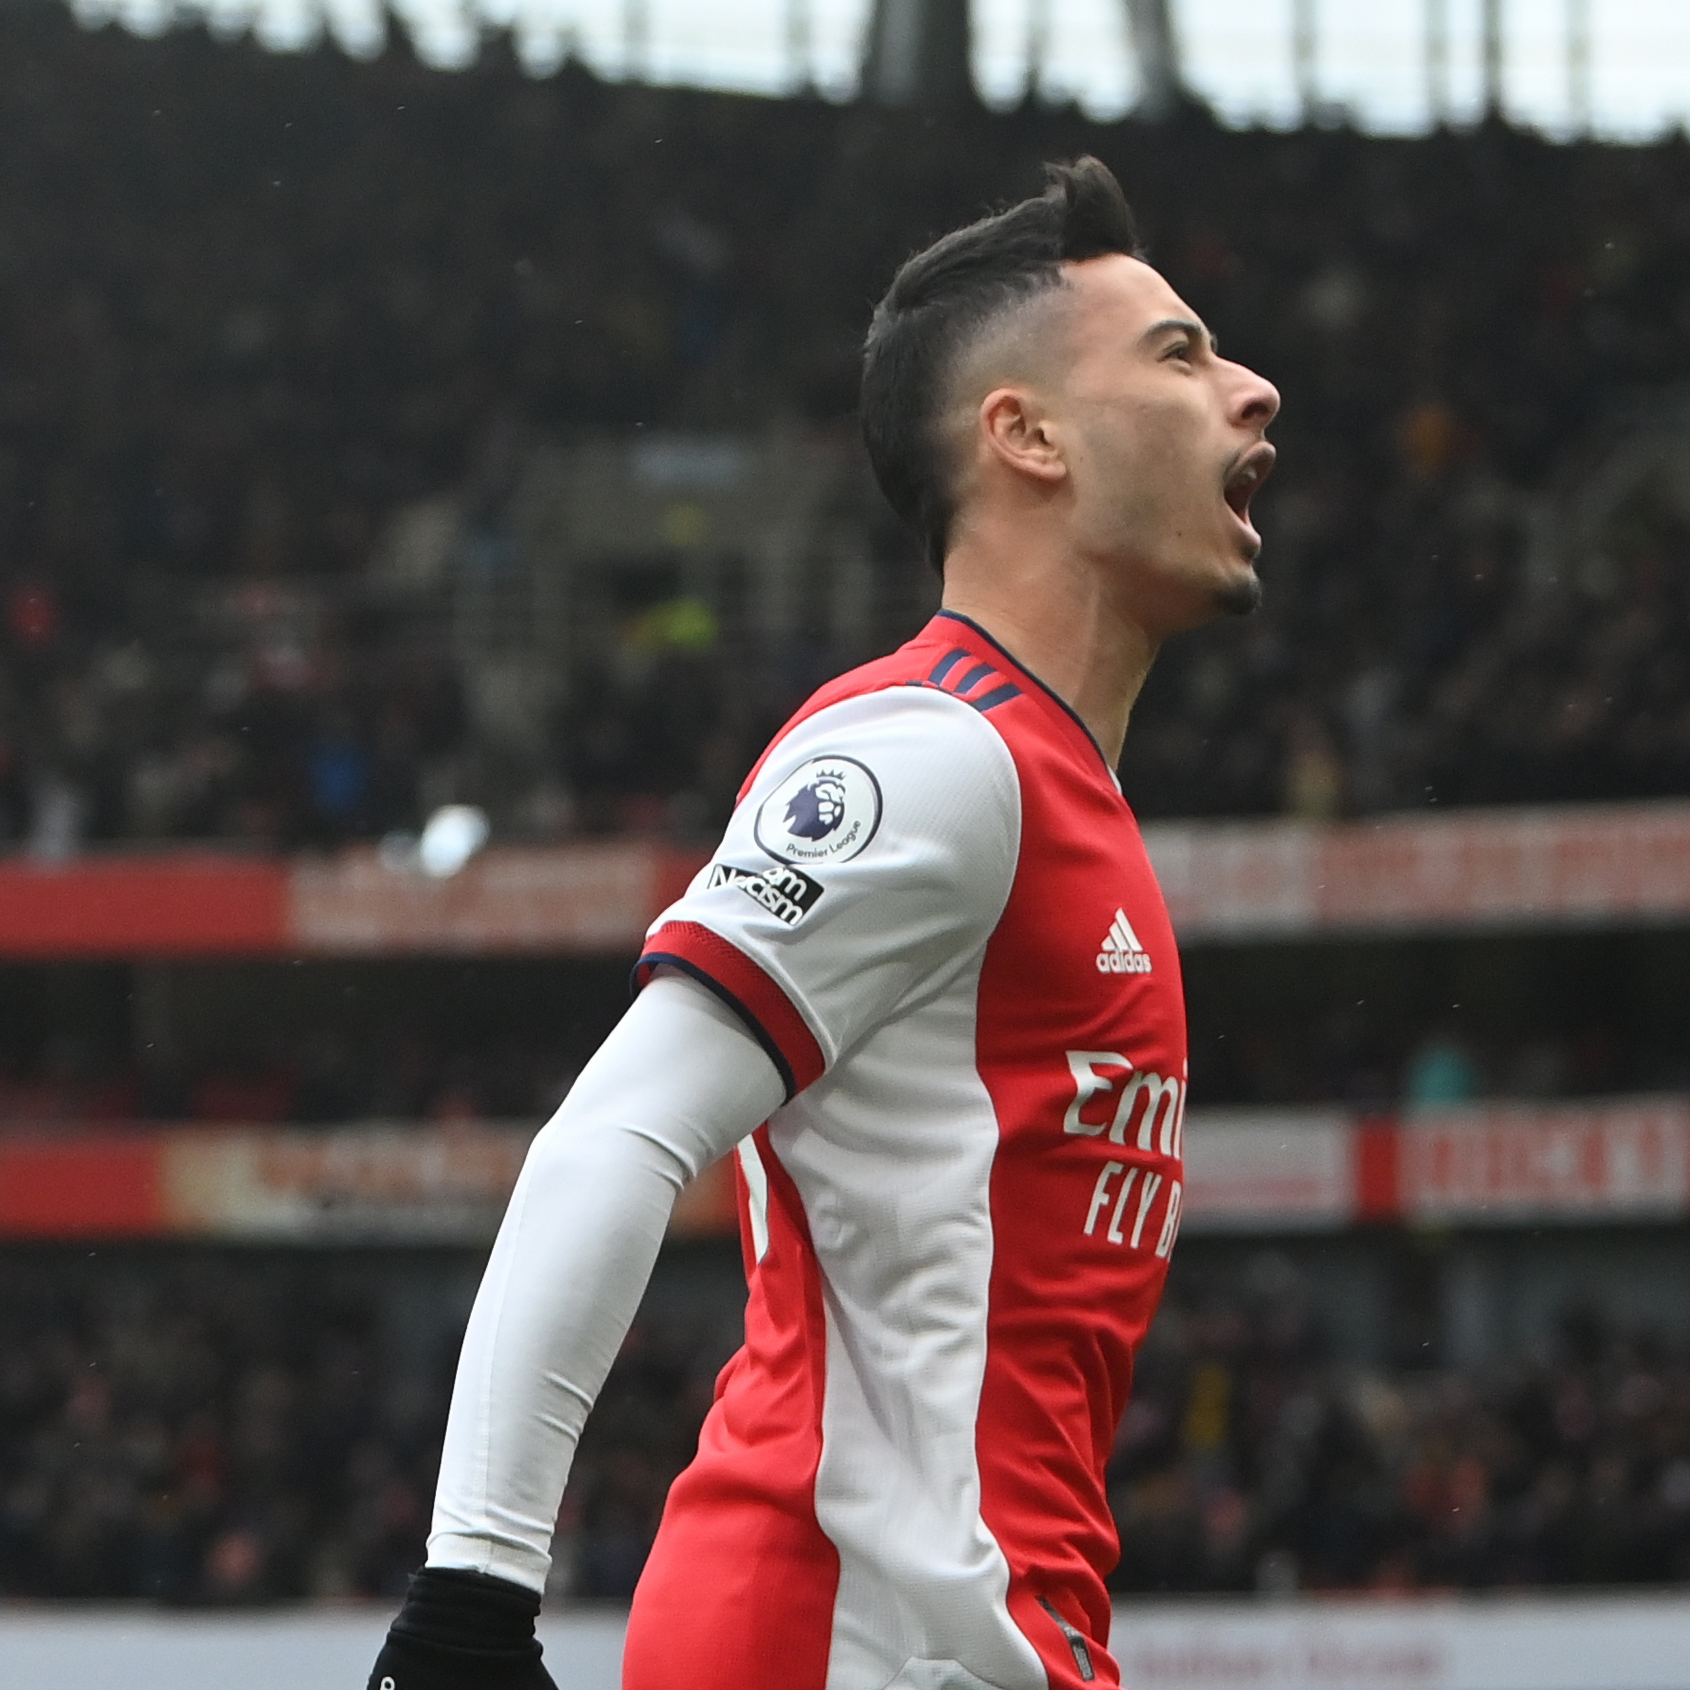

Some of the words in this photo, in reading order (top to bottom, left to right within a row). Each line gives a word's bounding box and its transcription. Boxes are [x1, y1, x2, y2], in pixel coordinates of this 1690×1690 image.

[786, 843, 828, 858] Premier
[829, 820, 862, 854] League
[1095, 949, 1153, 974] adidas
[1083, 1160, 1162, 1250] FLY
[1154, 1178, 1184, 1263] B
